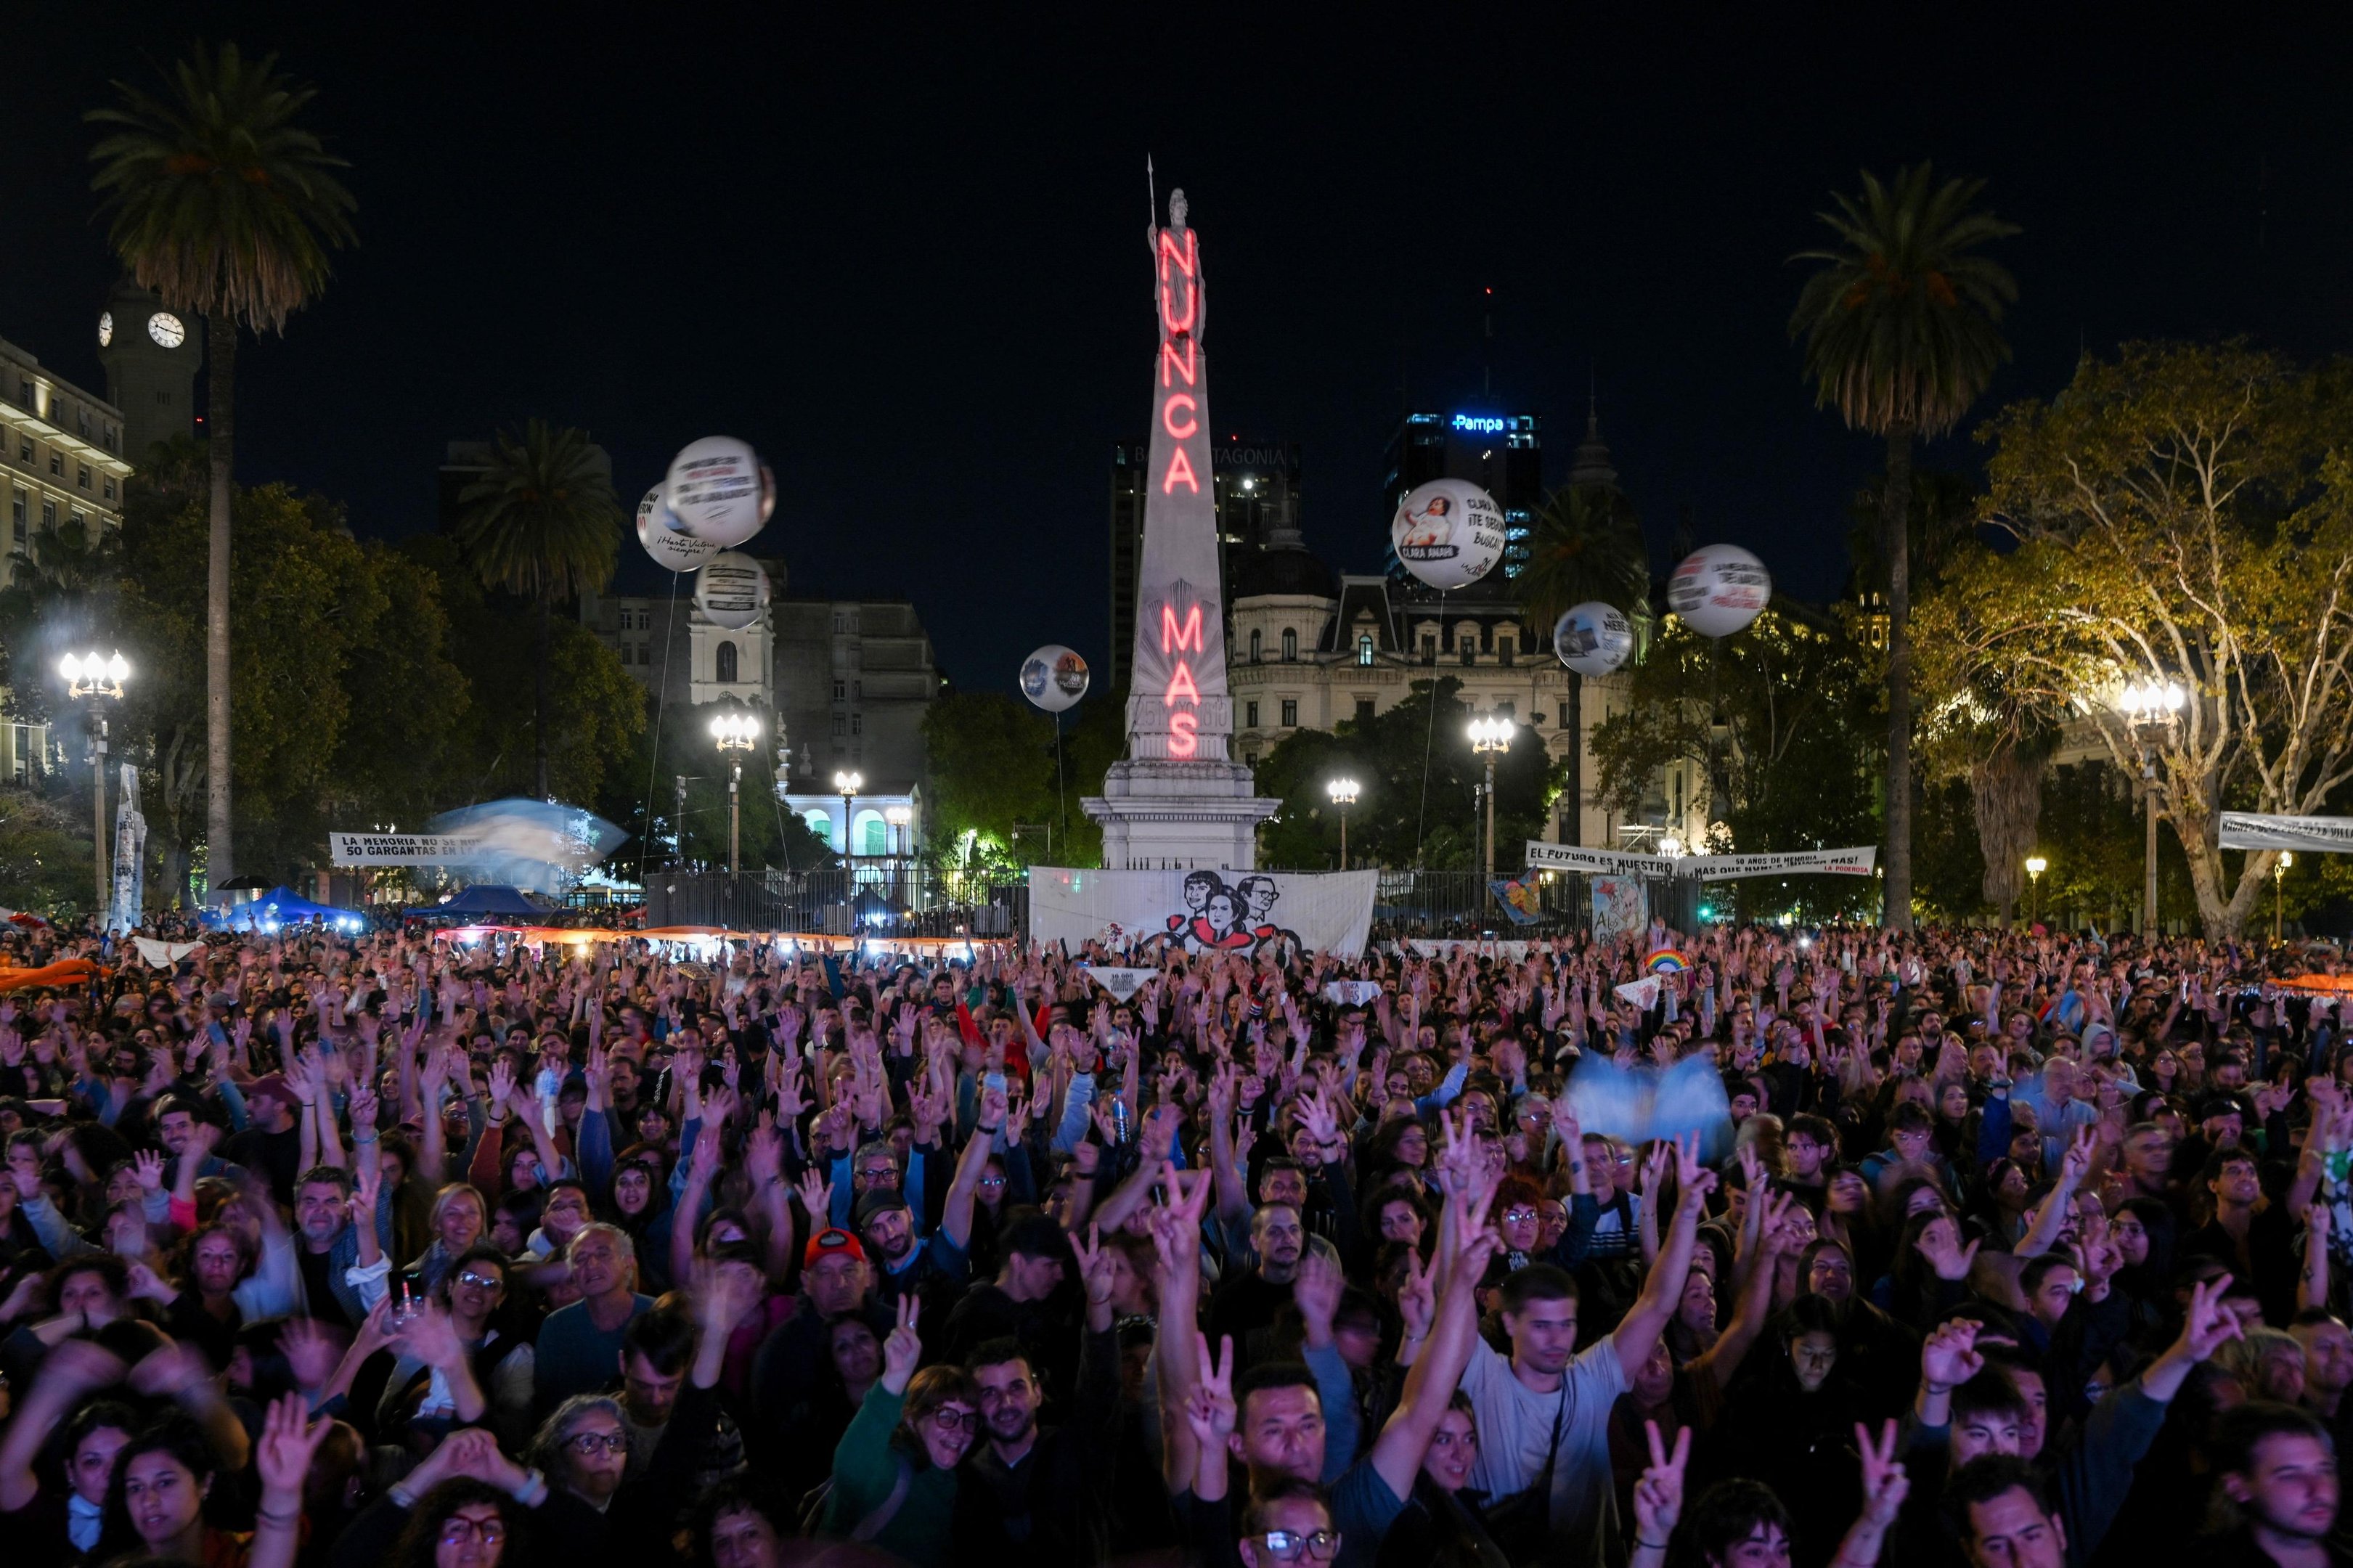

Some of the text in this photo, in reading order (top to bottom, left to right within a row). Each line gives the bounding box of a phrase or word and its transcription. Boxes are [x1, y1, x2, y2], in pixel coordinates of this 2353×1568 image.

[1454, 415, 1504, 433] Pampa
[1159, 228, 1203, 758] NUNCA MAS
[1403, 547, 1425, 558] CLARA
[342, 836, 358, 846] LA
[362, 837, 417, 846] MEMORIA
[346, 846, 362, 856] 50
[367, 846, 436, 856] GARGANTAS
[442, 846, 457, 855] EN
[1530, 848, 1543, 858] EL
[1599, 856, 1613, 866] ES
[1618, 859, 1673, 873] NUESTRO
[1748, 856, 1767, 865] AÑOS
[1594, 910, 1607, 931] A
